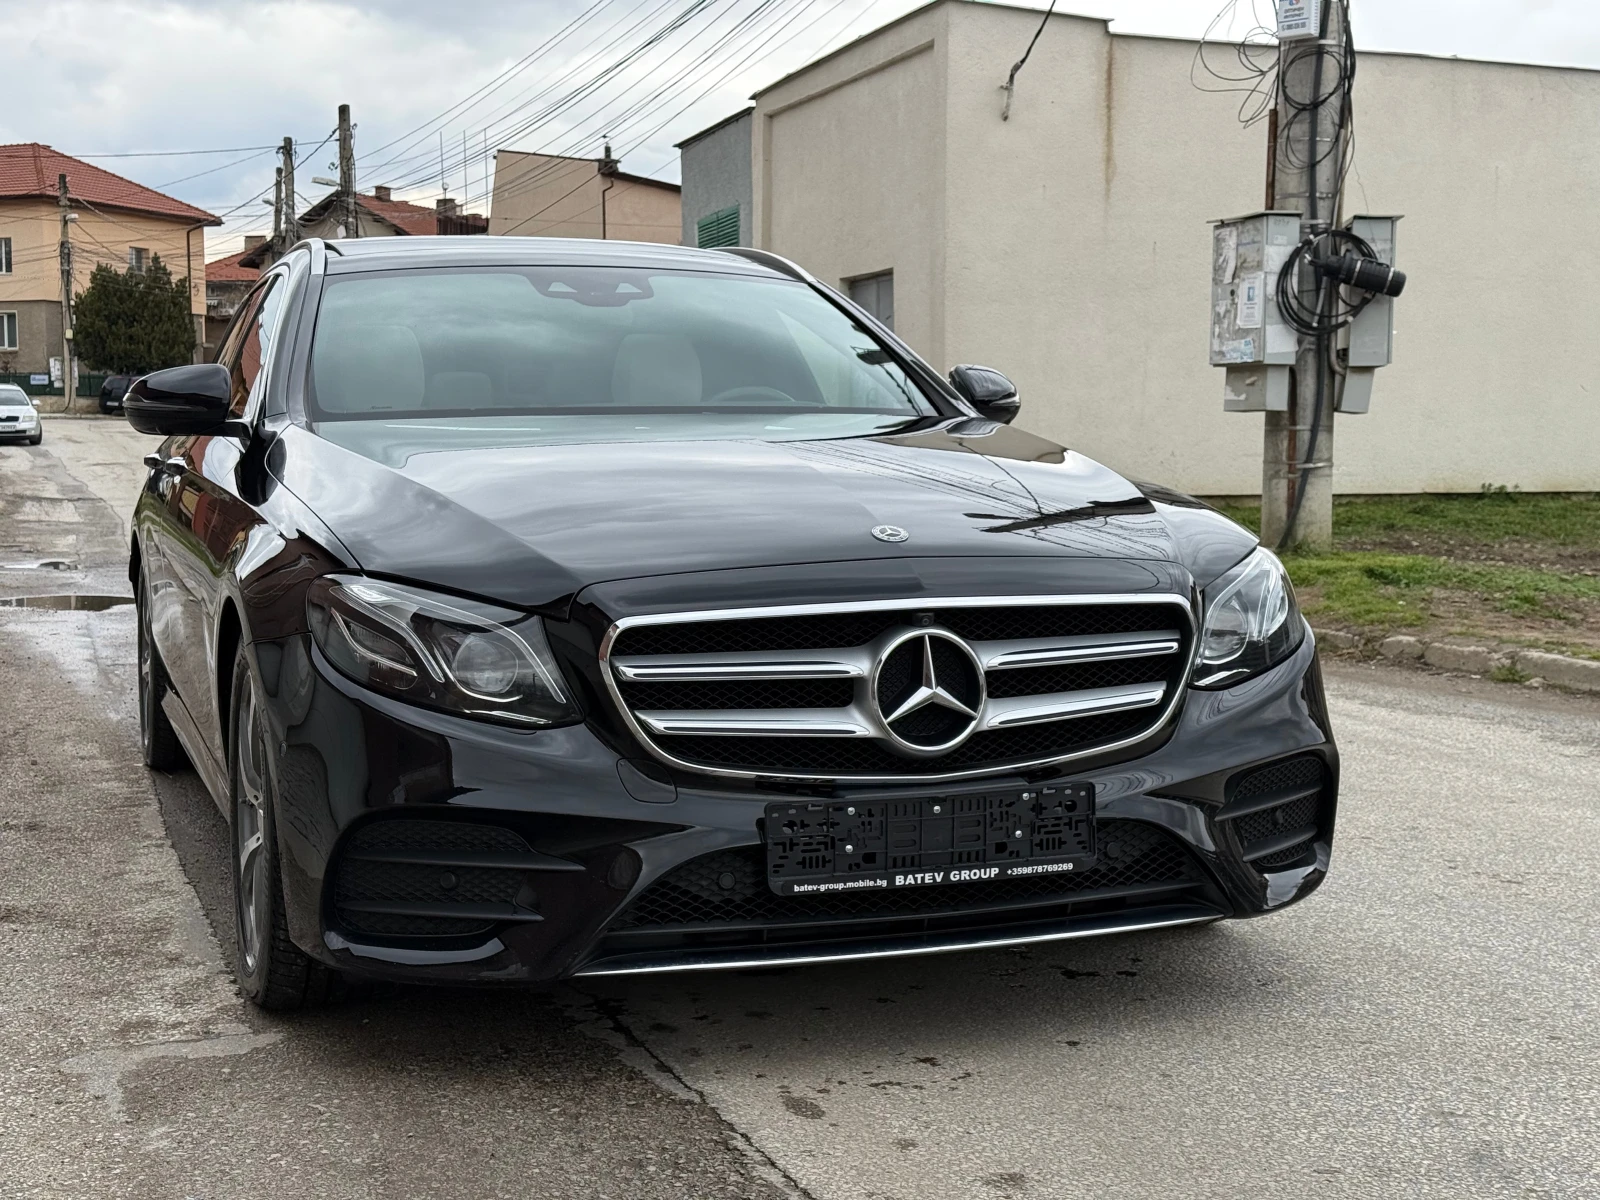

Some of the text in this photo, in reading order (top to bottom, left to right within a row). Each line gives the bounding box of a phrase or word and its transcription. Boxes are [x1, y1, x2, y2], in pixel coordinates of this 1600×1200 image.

[793, 862, 1074, 892] batev-group.mobile.bg BATEV GROUP +359878769269
